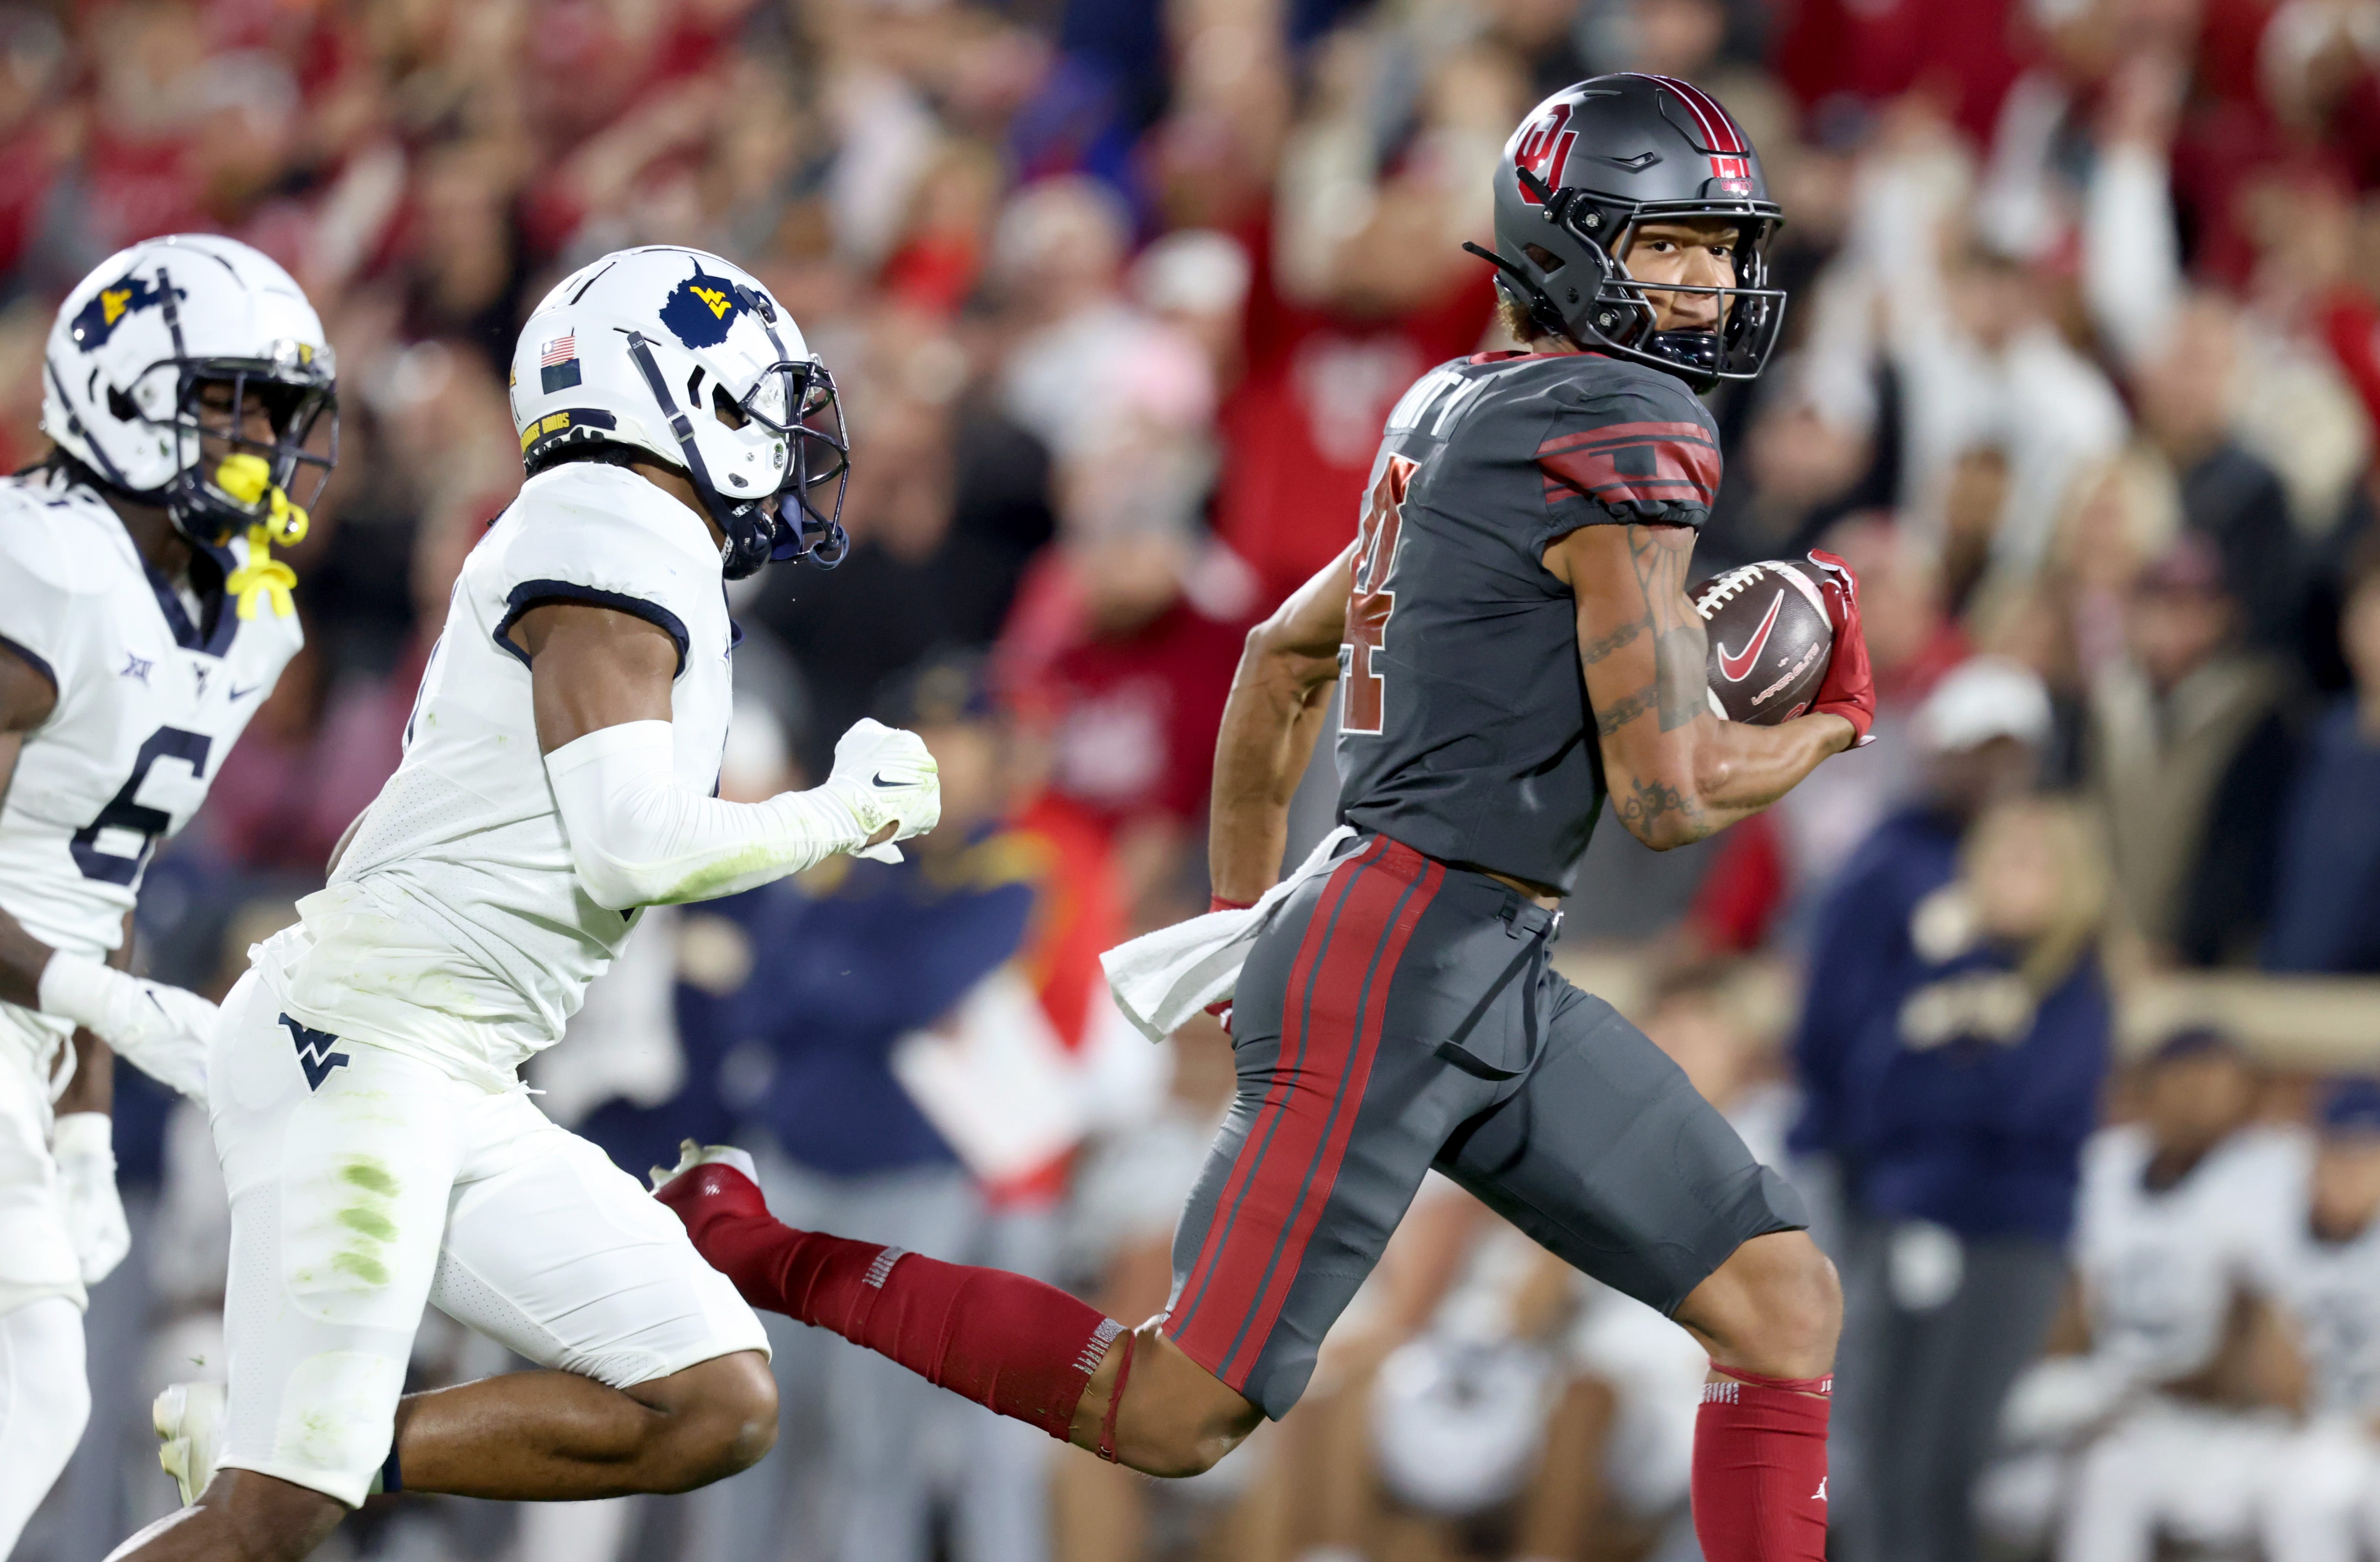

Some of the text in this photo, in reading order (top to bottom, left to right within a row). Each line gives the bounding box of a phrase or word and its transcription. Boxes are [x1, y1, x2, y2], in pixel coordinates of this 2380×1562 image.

[541, 412, 570, 434] ROADS
[1339, 454, 1421, 736] 4
[69, 725, 213, 886] 6
